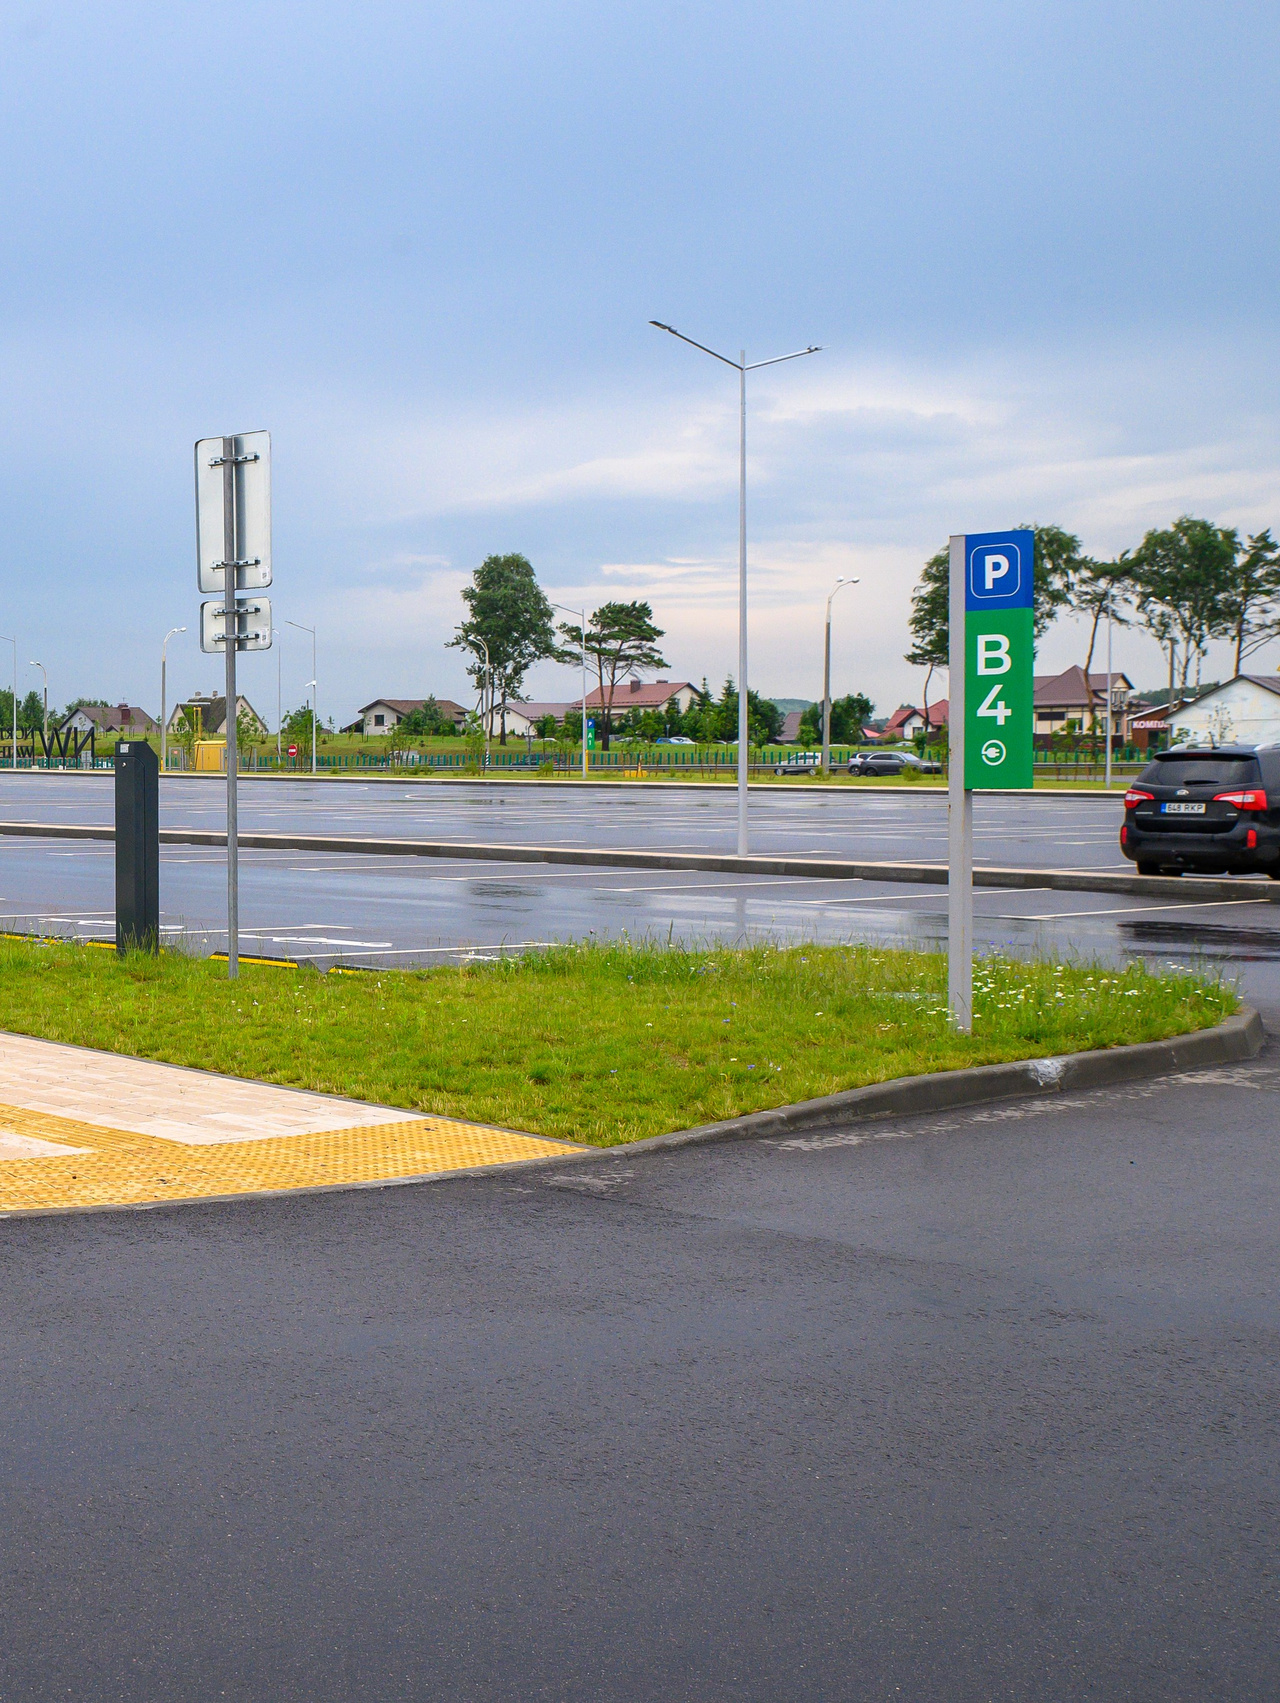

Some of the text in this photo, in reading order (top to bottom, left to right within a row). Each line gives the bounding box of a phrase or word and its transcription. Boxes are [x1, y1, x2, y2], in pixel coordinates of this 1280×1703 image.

[984, 554, 1010, 590] P
[976, 633, 1012, 676] B
[976, 684, 1012, 726] 4
[1184, 804, 1203, 812] RKP
